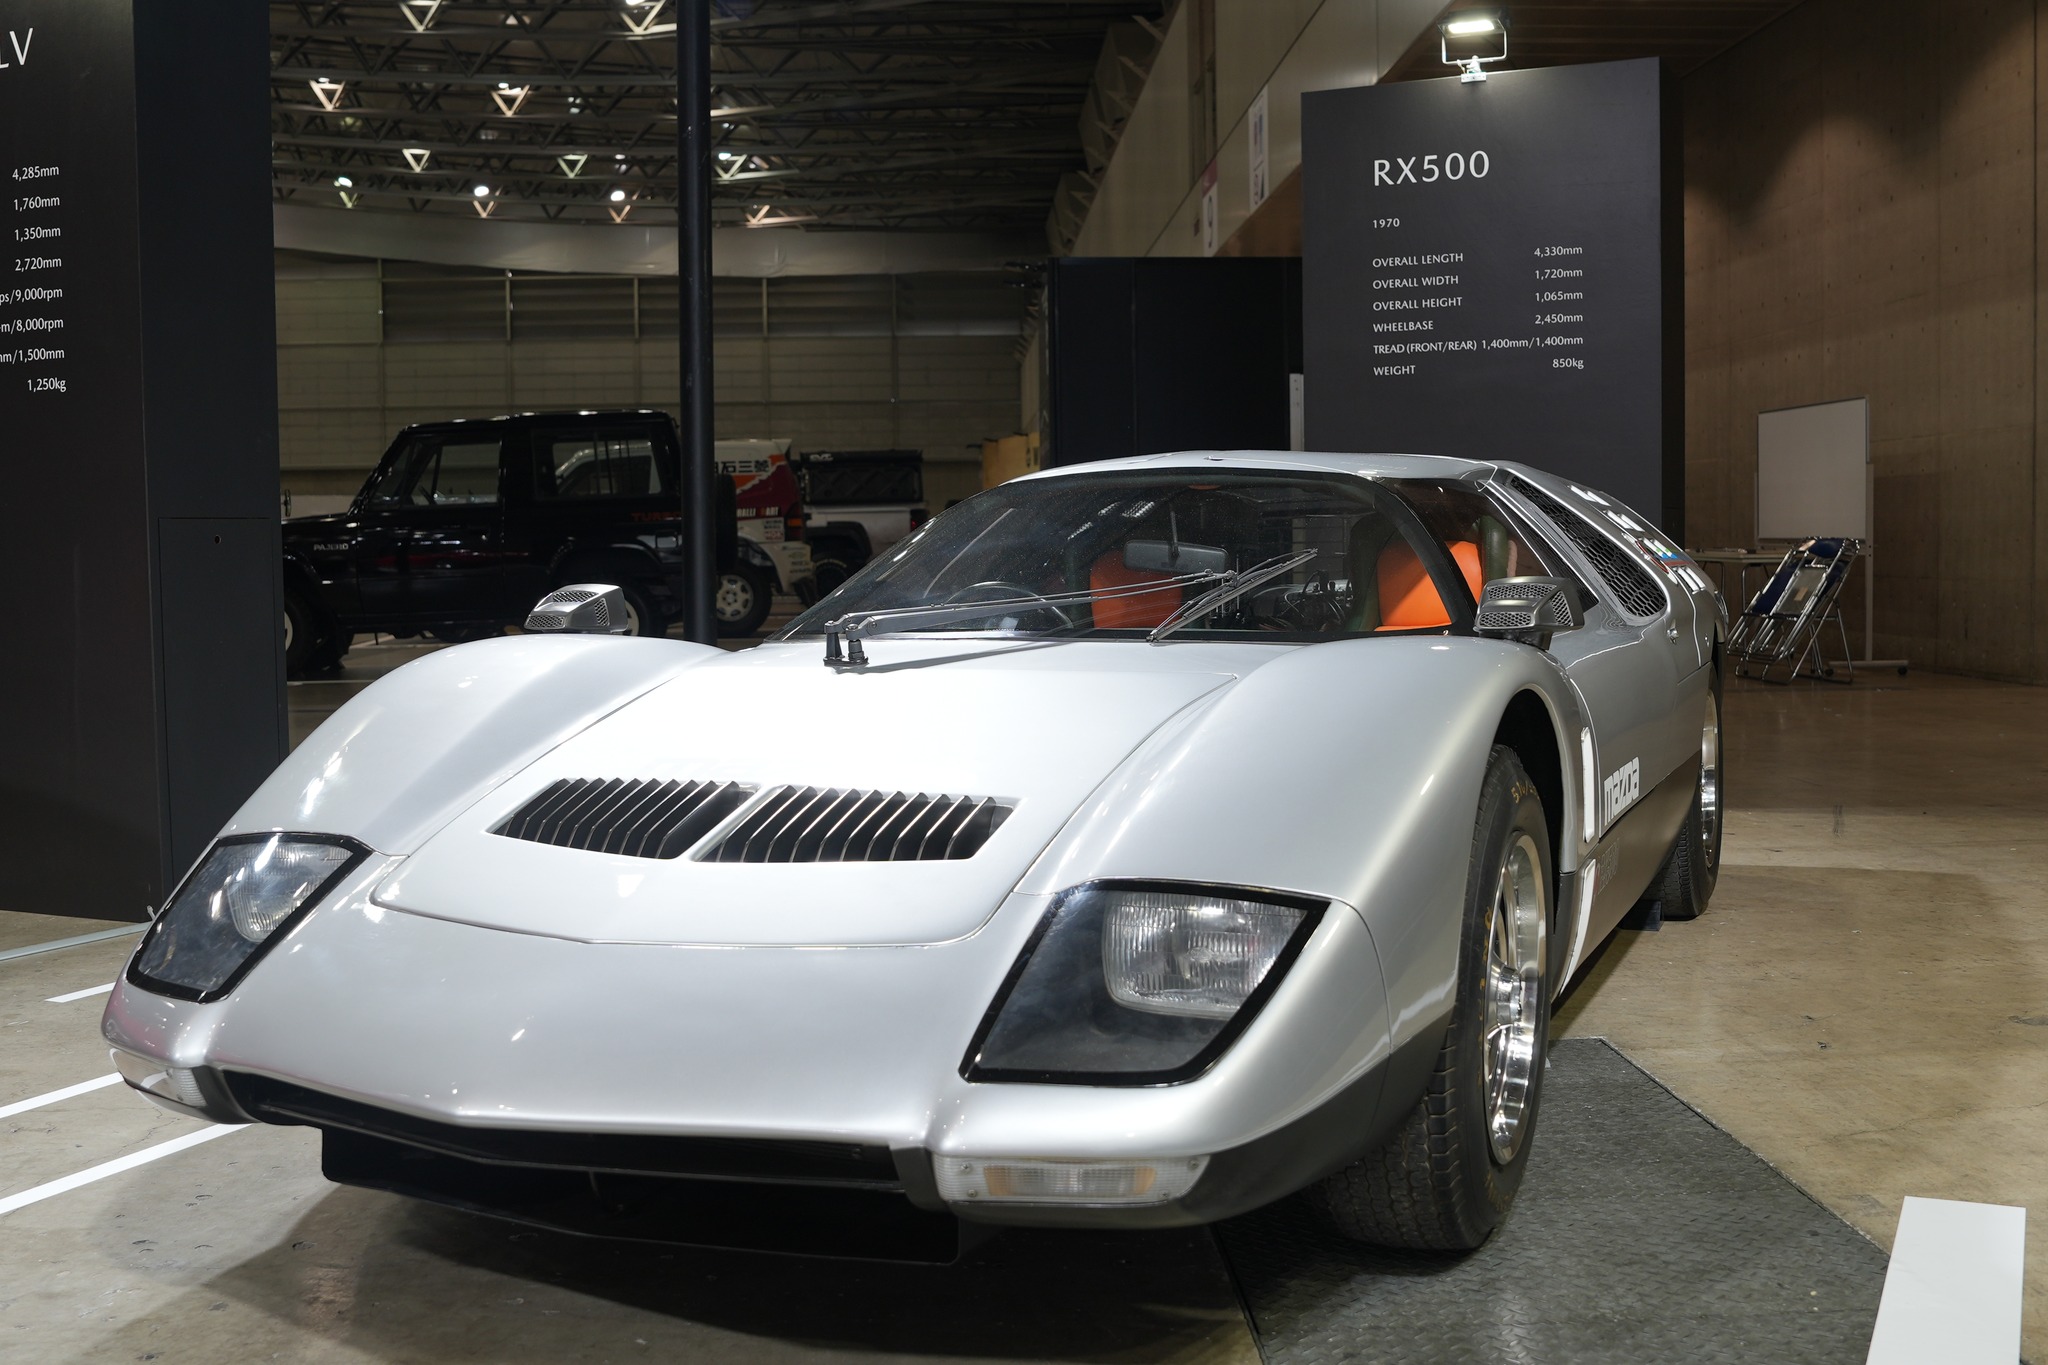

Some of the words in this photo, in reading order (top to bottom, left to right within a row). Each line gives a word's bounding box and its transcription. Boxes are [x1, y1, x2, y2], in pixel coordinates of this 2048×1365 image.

[11, 165, 60, 182] 4,285mm
[1373, 150, 1490, 187] RX500
[13, 196, 60, 212] 1,760mm
[1372, 217, 1400, 229] 1970
[14, 226, 61, 242] 1,350mm
[15, 256, 62, 272] 2,720mm
[1372, 255, 1418, 268] OVERALL
[1421, 252, 1464, 265] LENGTH
[1534, 245, 1583, 258] 4,330mm
[1372, 277, 1418, 290] OVERALL
[1421, 274, 1459, 287] WIDTH
[1535, 268, 1583, 281] 1,720mm
[1372, 299, 1419, 311] OVERALL
[1422, 296, 1463, 309] HEIGHT
[1535, 290, 1583, 303] 1,065mm
[0, 317, 64, 335] m/8,000rpm
[1373, 320, 1434, 333] WHEELBASE
[1535, 313, 1583, 325] 2,450mm
[1373, 344, 1405, 355] TREAD
[1407, 340, 1477, 355] (FRONT/REAR)
[1482, 335, 1583, 351] 1,400mm/1,400mm
[1373, 364, 1416, 376] WEIGHT
[1552, 357, 1584, 370] 850kg
[27, 377, 67, 393] 1,250kg
[714, 460, 770, 474] 石三菱
[1604, 756, 1640, 827] mazda
